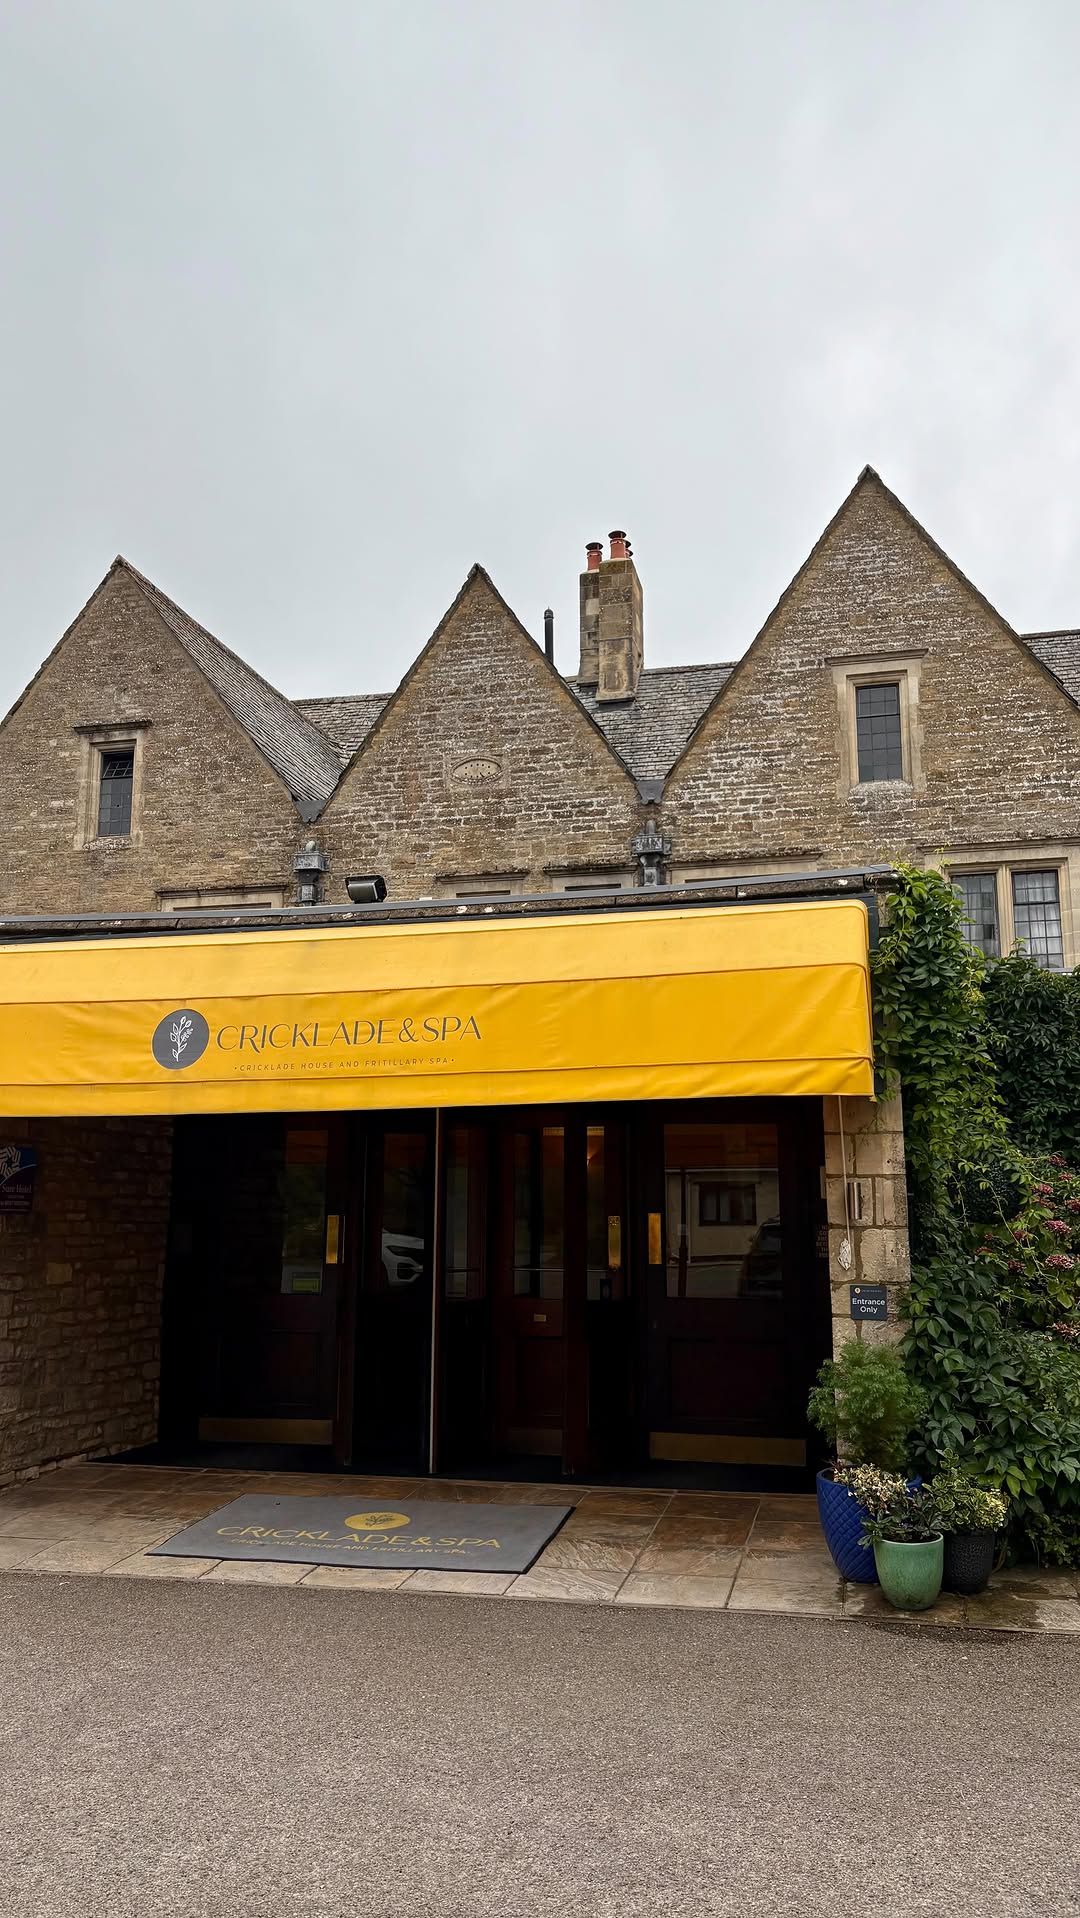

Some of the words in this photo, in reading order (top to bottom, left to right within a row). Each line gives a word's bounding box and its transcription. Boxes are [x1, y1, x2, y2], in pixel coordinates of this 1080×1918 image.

[365, 1058, 424, 1067] FRITILLARY
[852, 1297, 886, 1306] Entrance
[860, 1306, 878, 1314] Only
